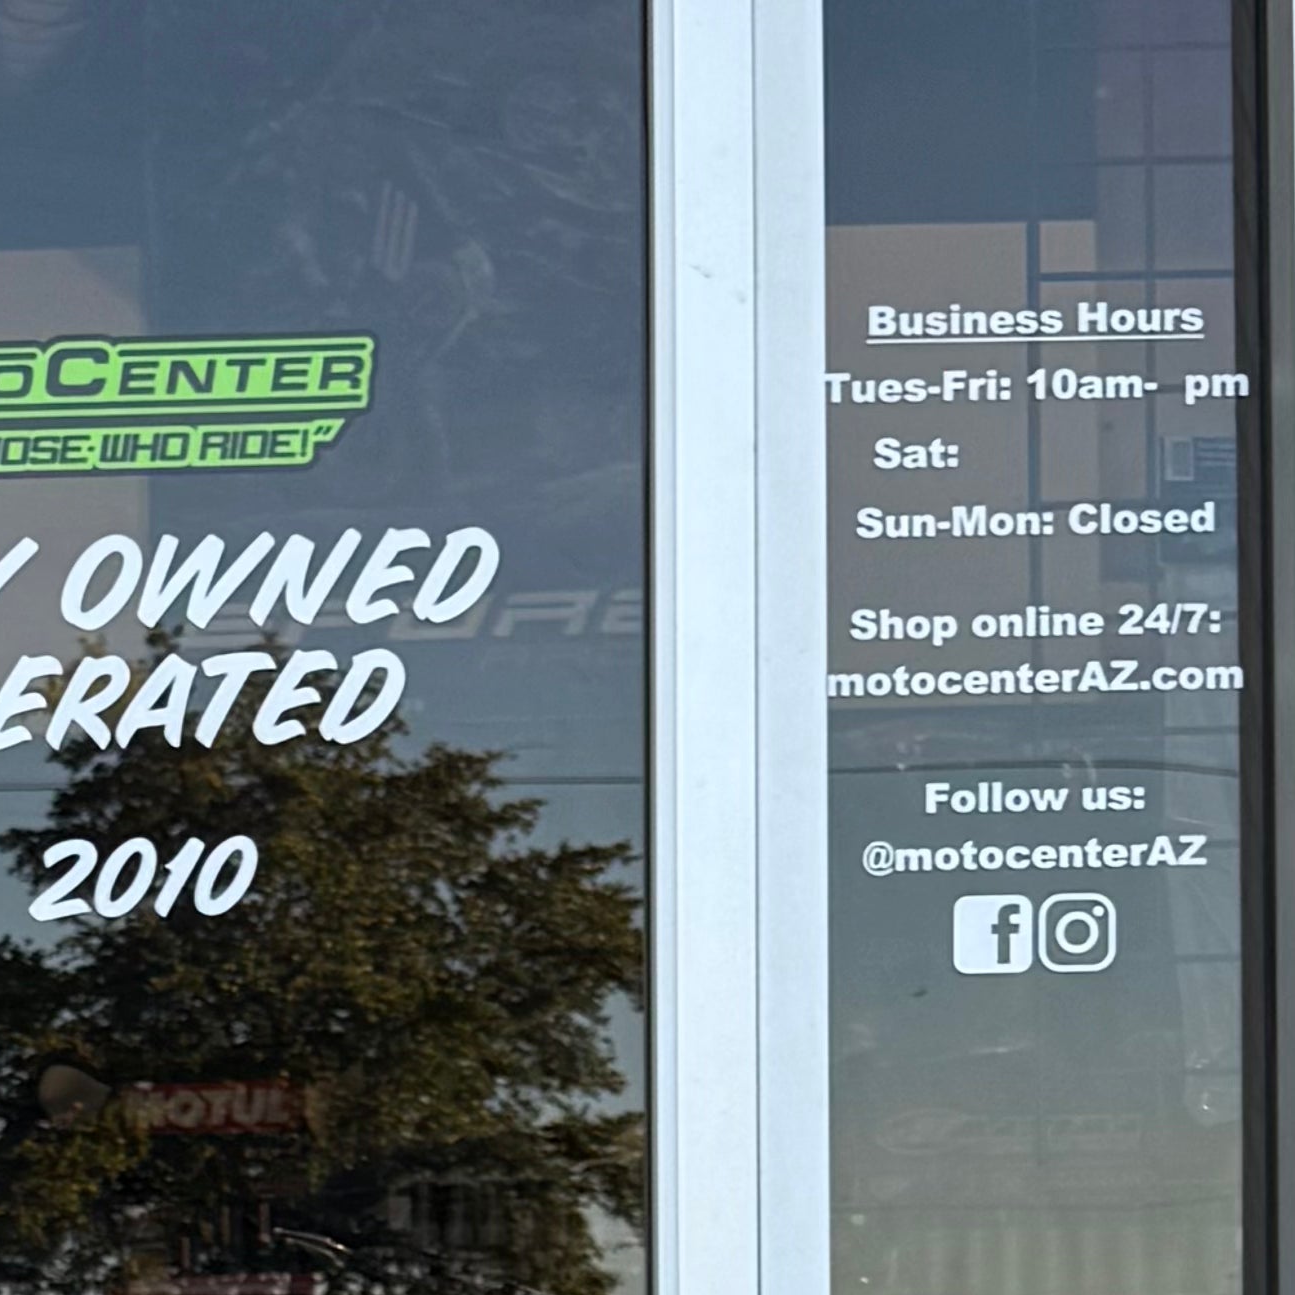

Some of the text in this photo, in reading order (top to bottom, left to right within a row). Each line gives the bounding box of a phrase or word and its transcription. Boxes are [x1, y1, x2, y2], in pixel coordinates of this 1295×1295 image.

[868, 301, 1204, 336] Business Hours
[825, 368, 1249, 405] Tues-Fri: 10am- pm
[873, 437, 959, 469] Sat:
[856, 501, 1215, 539] Sun-Mon: Closed
[60, 526, 499, 631] OWNED
[849, 603, 1222, 647] Shop online 24/7:
[827, 660, 1244, 697] motocenterAZ.com
[925, 781, 1145, 814] Follow us:
[862, 834, 1208, 877] @motocenterAZ
[28, 834, 259, 922] 2010
